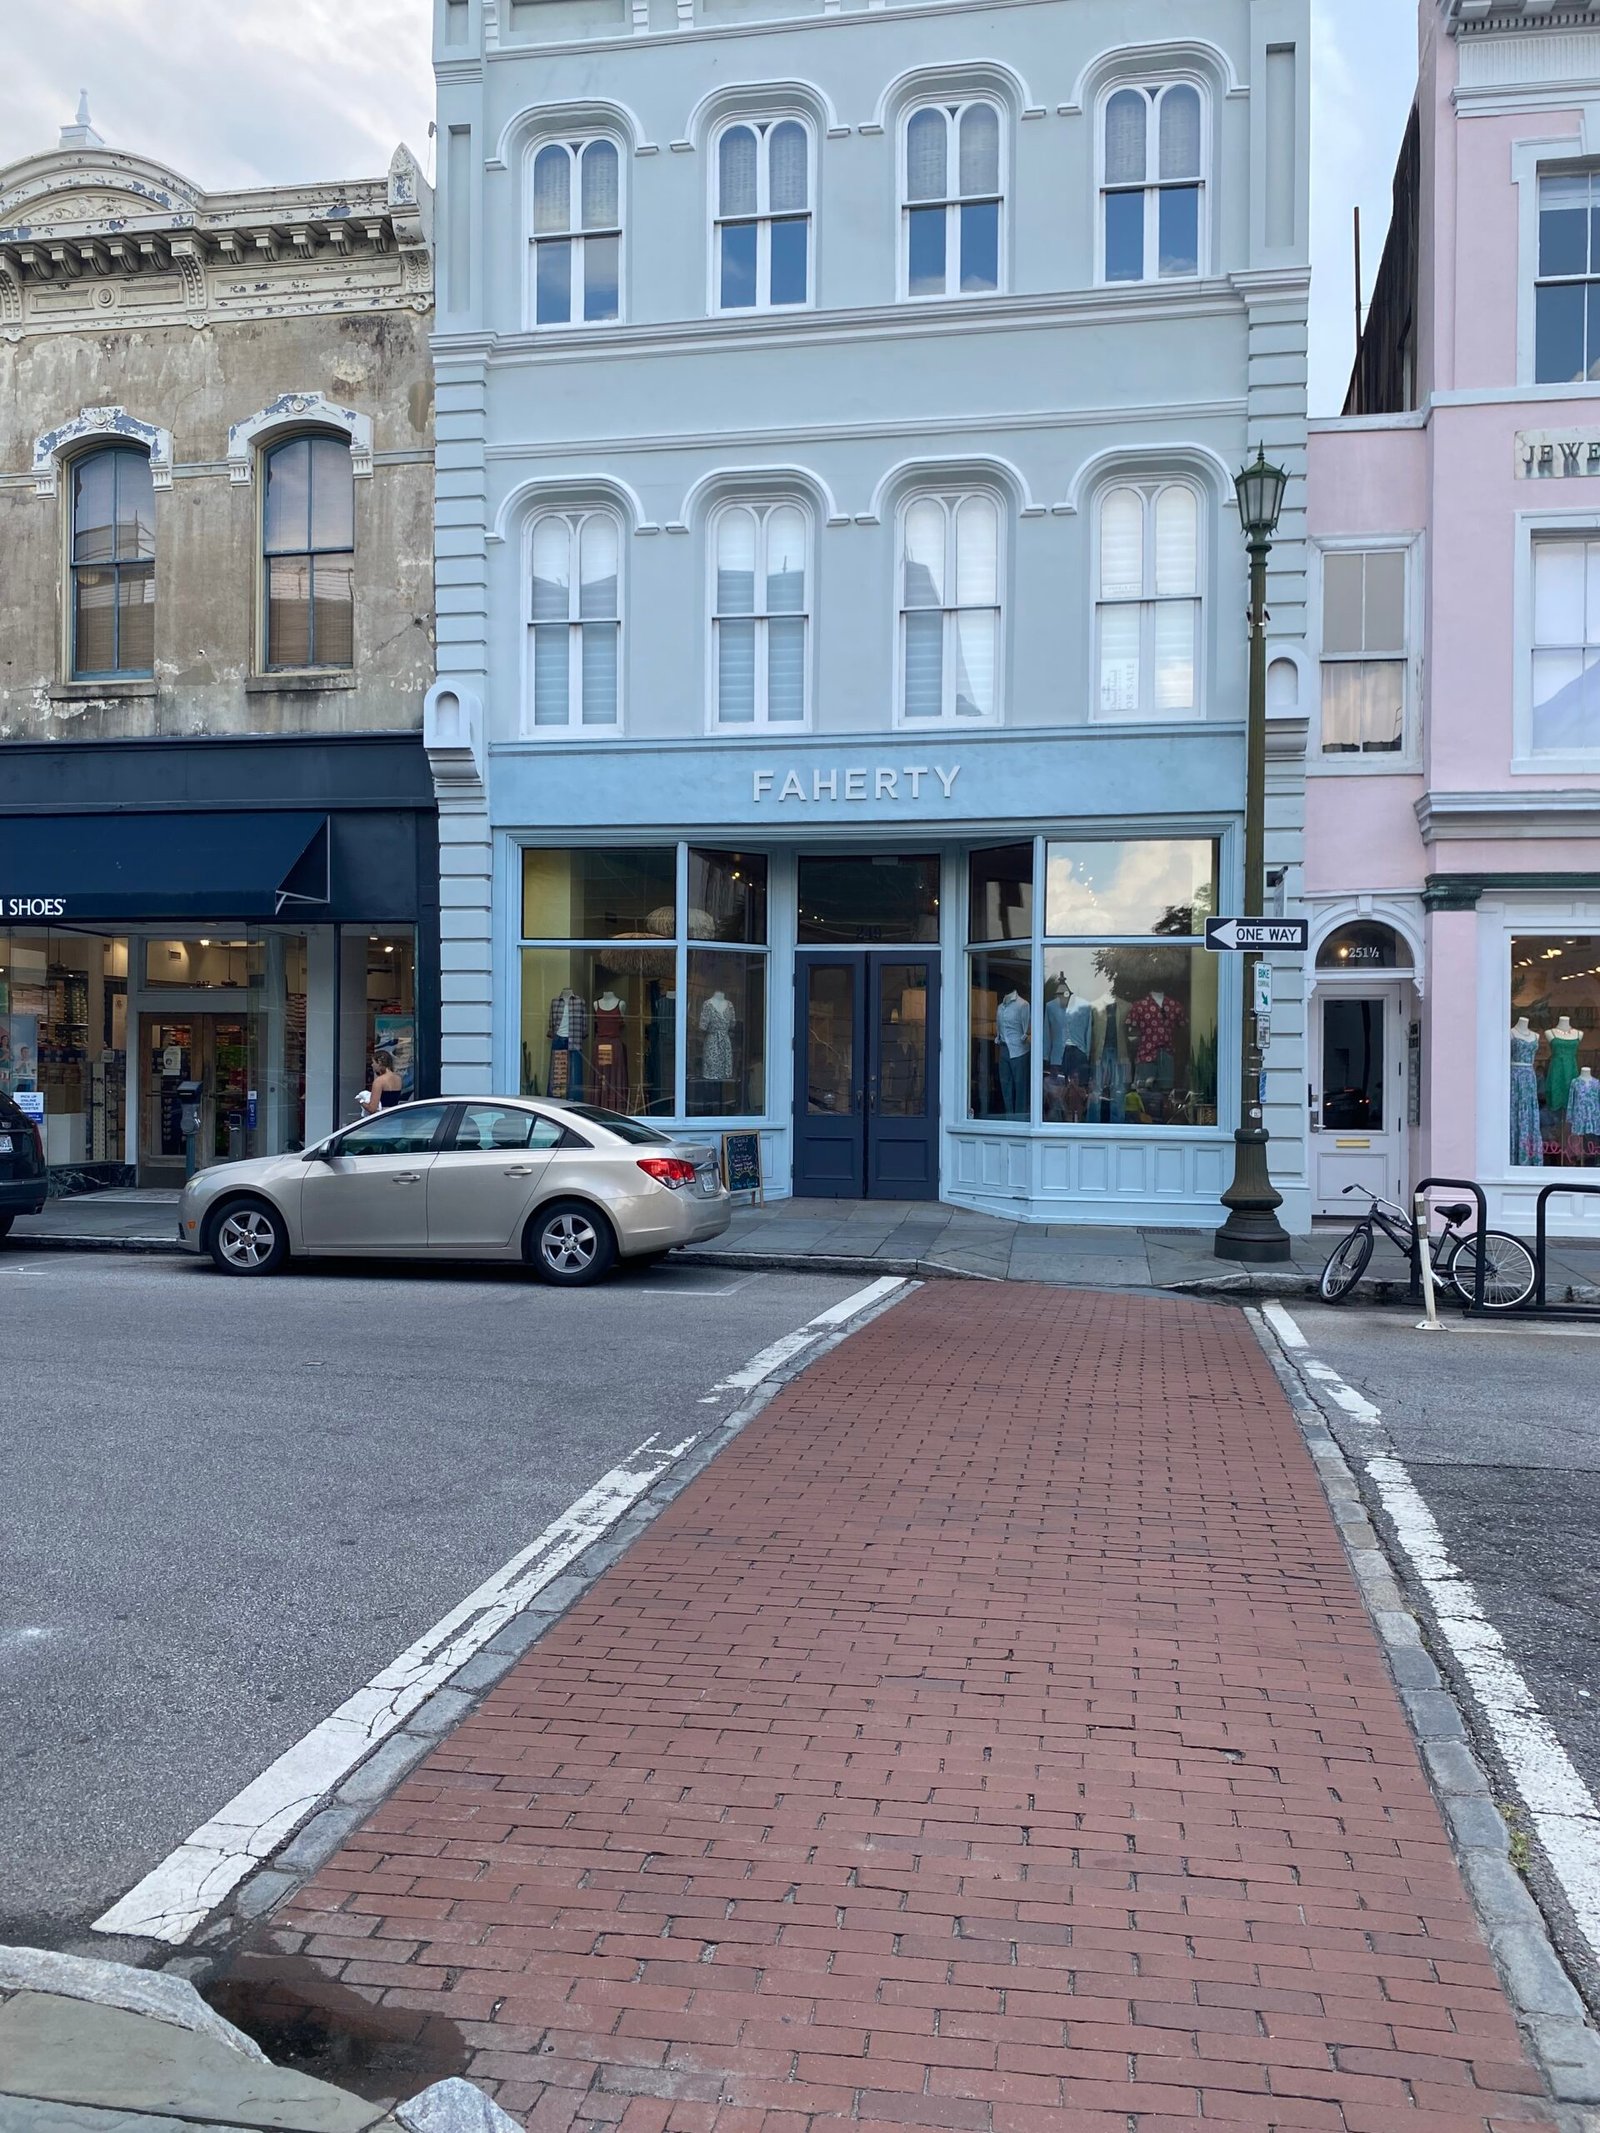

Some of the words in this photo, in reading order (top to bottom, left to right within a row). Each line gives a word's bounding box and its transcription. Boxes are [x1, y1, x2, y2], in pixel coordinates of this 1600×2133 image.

[752, 765, 961, 802] FAHERTY
[9, 898, 64, 916] SHOES
[1236, 928, 1264, 941] ONE
[1269, 928, 1297, 941] WAY
